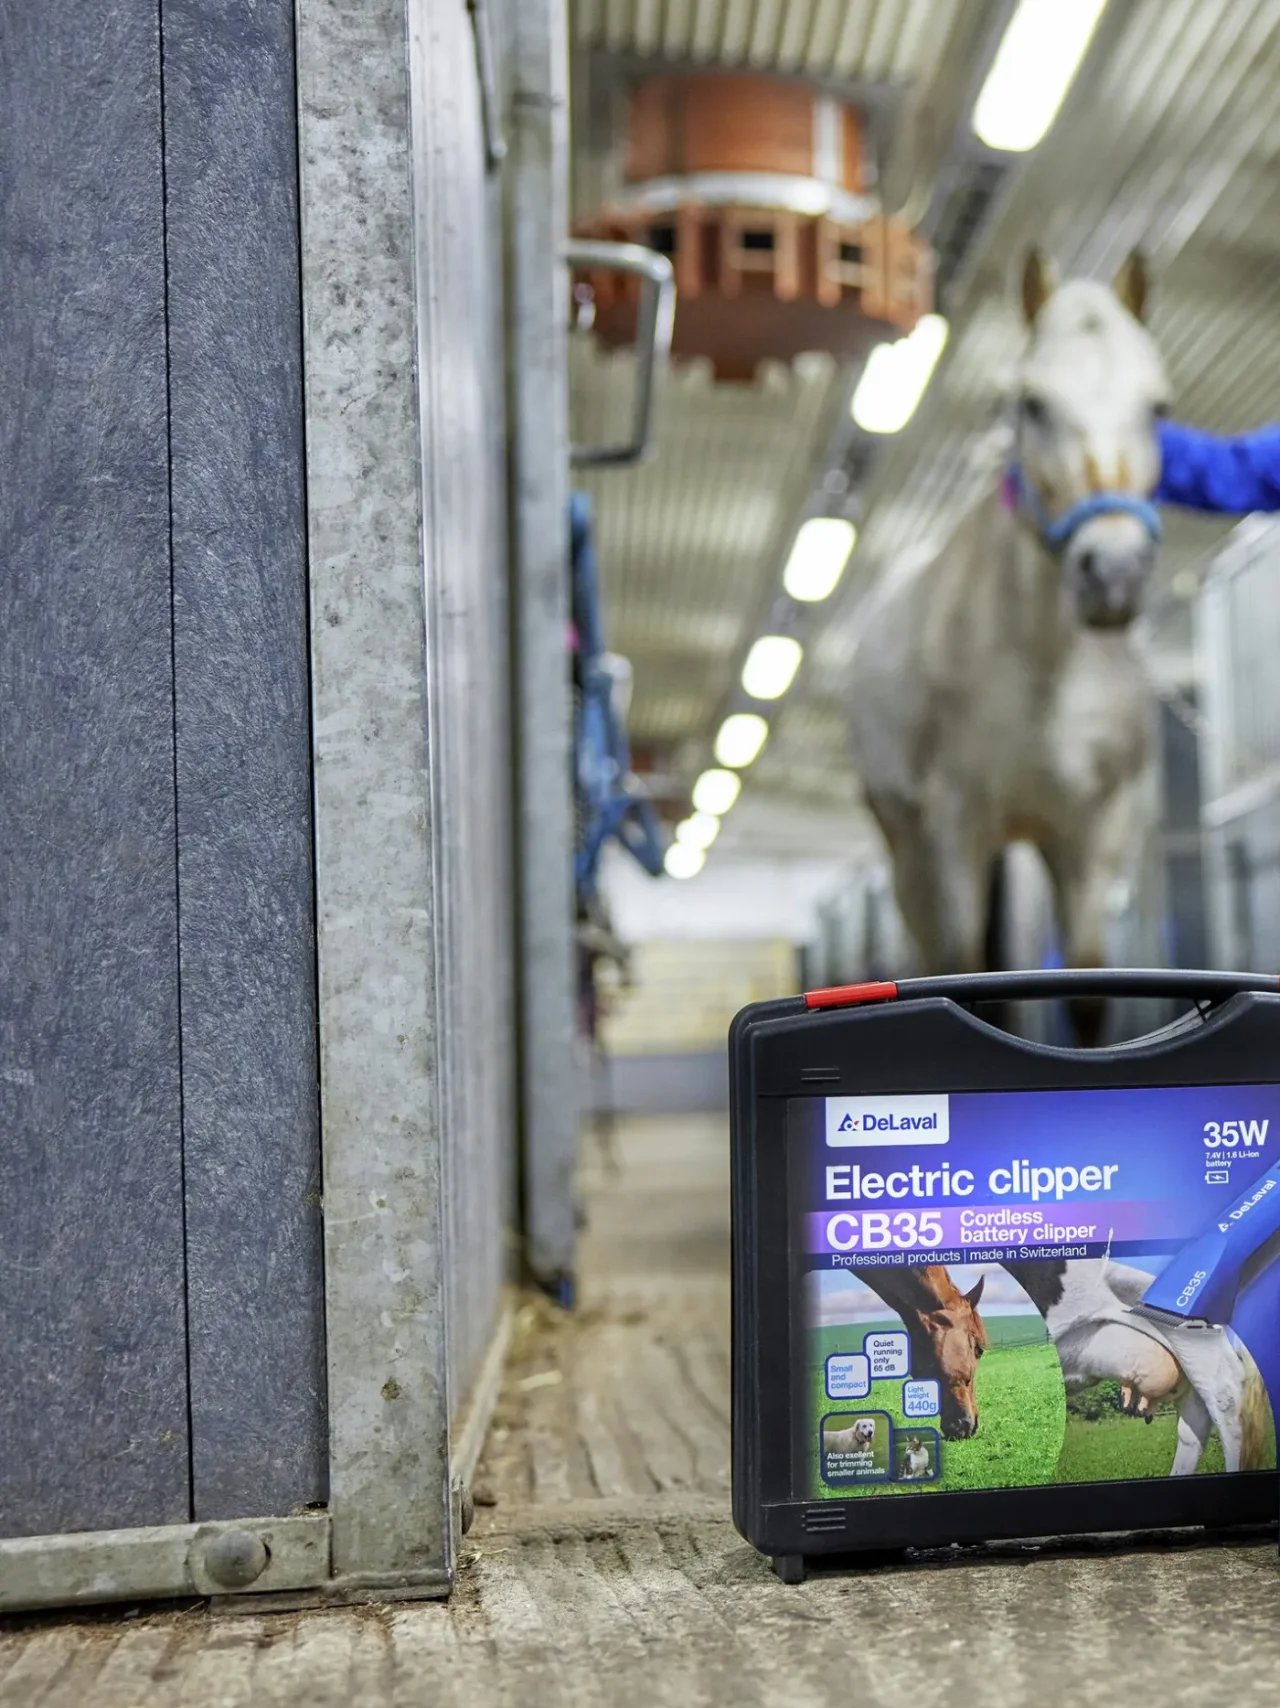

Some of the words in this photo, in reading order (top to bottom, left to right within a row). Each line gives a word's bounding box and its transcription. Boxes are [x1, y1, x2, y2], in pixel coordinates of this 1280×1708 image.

[863, 1113, 937, 1131] DeLaval
[1203, 1119, 1269, 1148] 35W
[1205, 1151, 1221, 1159] 7.4V
[1238, 1150, 1260, 1158] Li-ion
[1205, 1159, 1232, 1168] battery
[825, 1163, 974, 1200] Electric
[988, 1160, 1118, 1201] clipper
[1229, 1180, 1277, 1220] DeLaval
[960, 1209, 1043, 1227] Cordless
[826, 1212, 943, 1250] CB35
[960, 1226, 1028, 1244] battery
[1033, 1224, 1097, 1242] clipper
[832, 1252, 904, 1266] Professional
[908, 1251, 961, 1266] products
[970, 1249, 1004, 1260] made
[1006, 1248, 1016, 1259] in
[1020, 1245, 1087, 1258] Switzerland
[1176, 1270, 1206, 1307] CB35
[873, 1340, 894, 1348] Quiet
[873, 1348, 903, 1356] running
[873, 1356, 890, 1364] only
[830, 1365, 853, 1373] Small
[831, 1381, 867, 1389] compact
[907, 1400, 937, 1412] 440g
[827, 1452, 844, 1460] Also
[827, 1461, 838, 1469] for
[827, 1469, 855, 1477] smaller
[856, 1467, 885, 1475] animals
